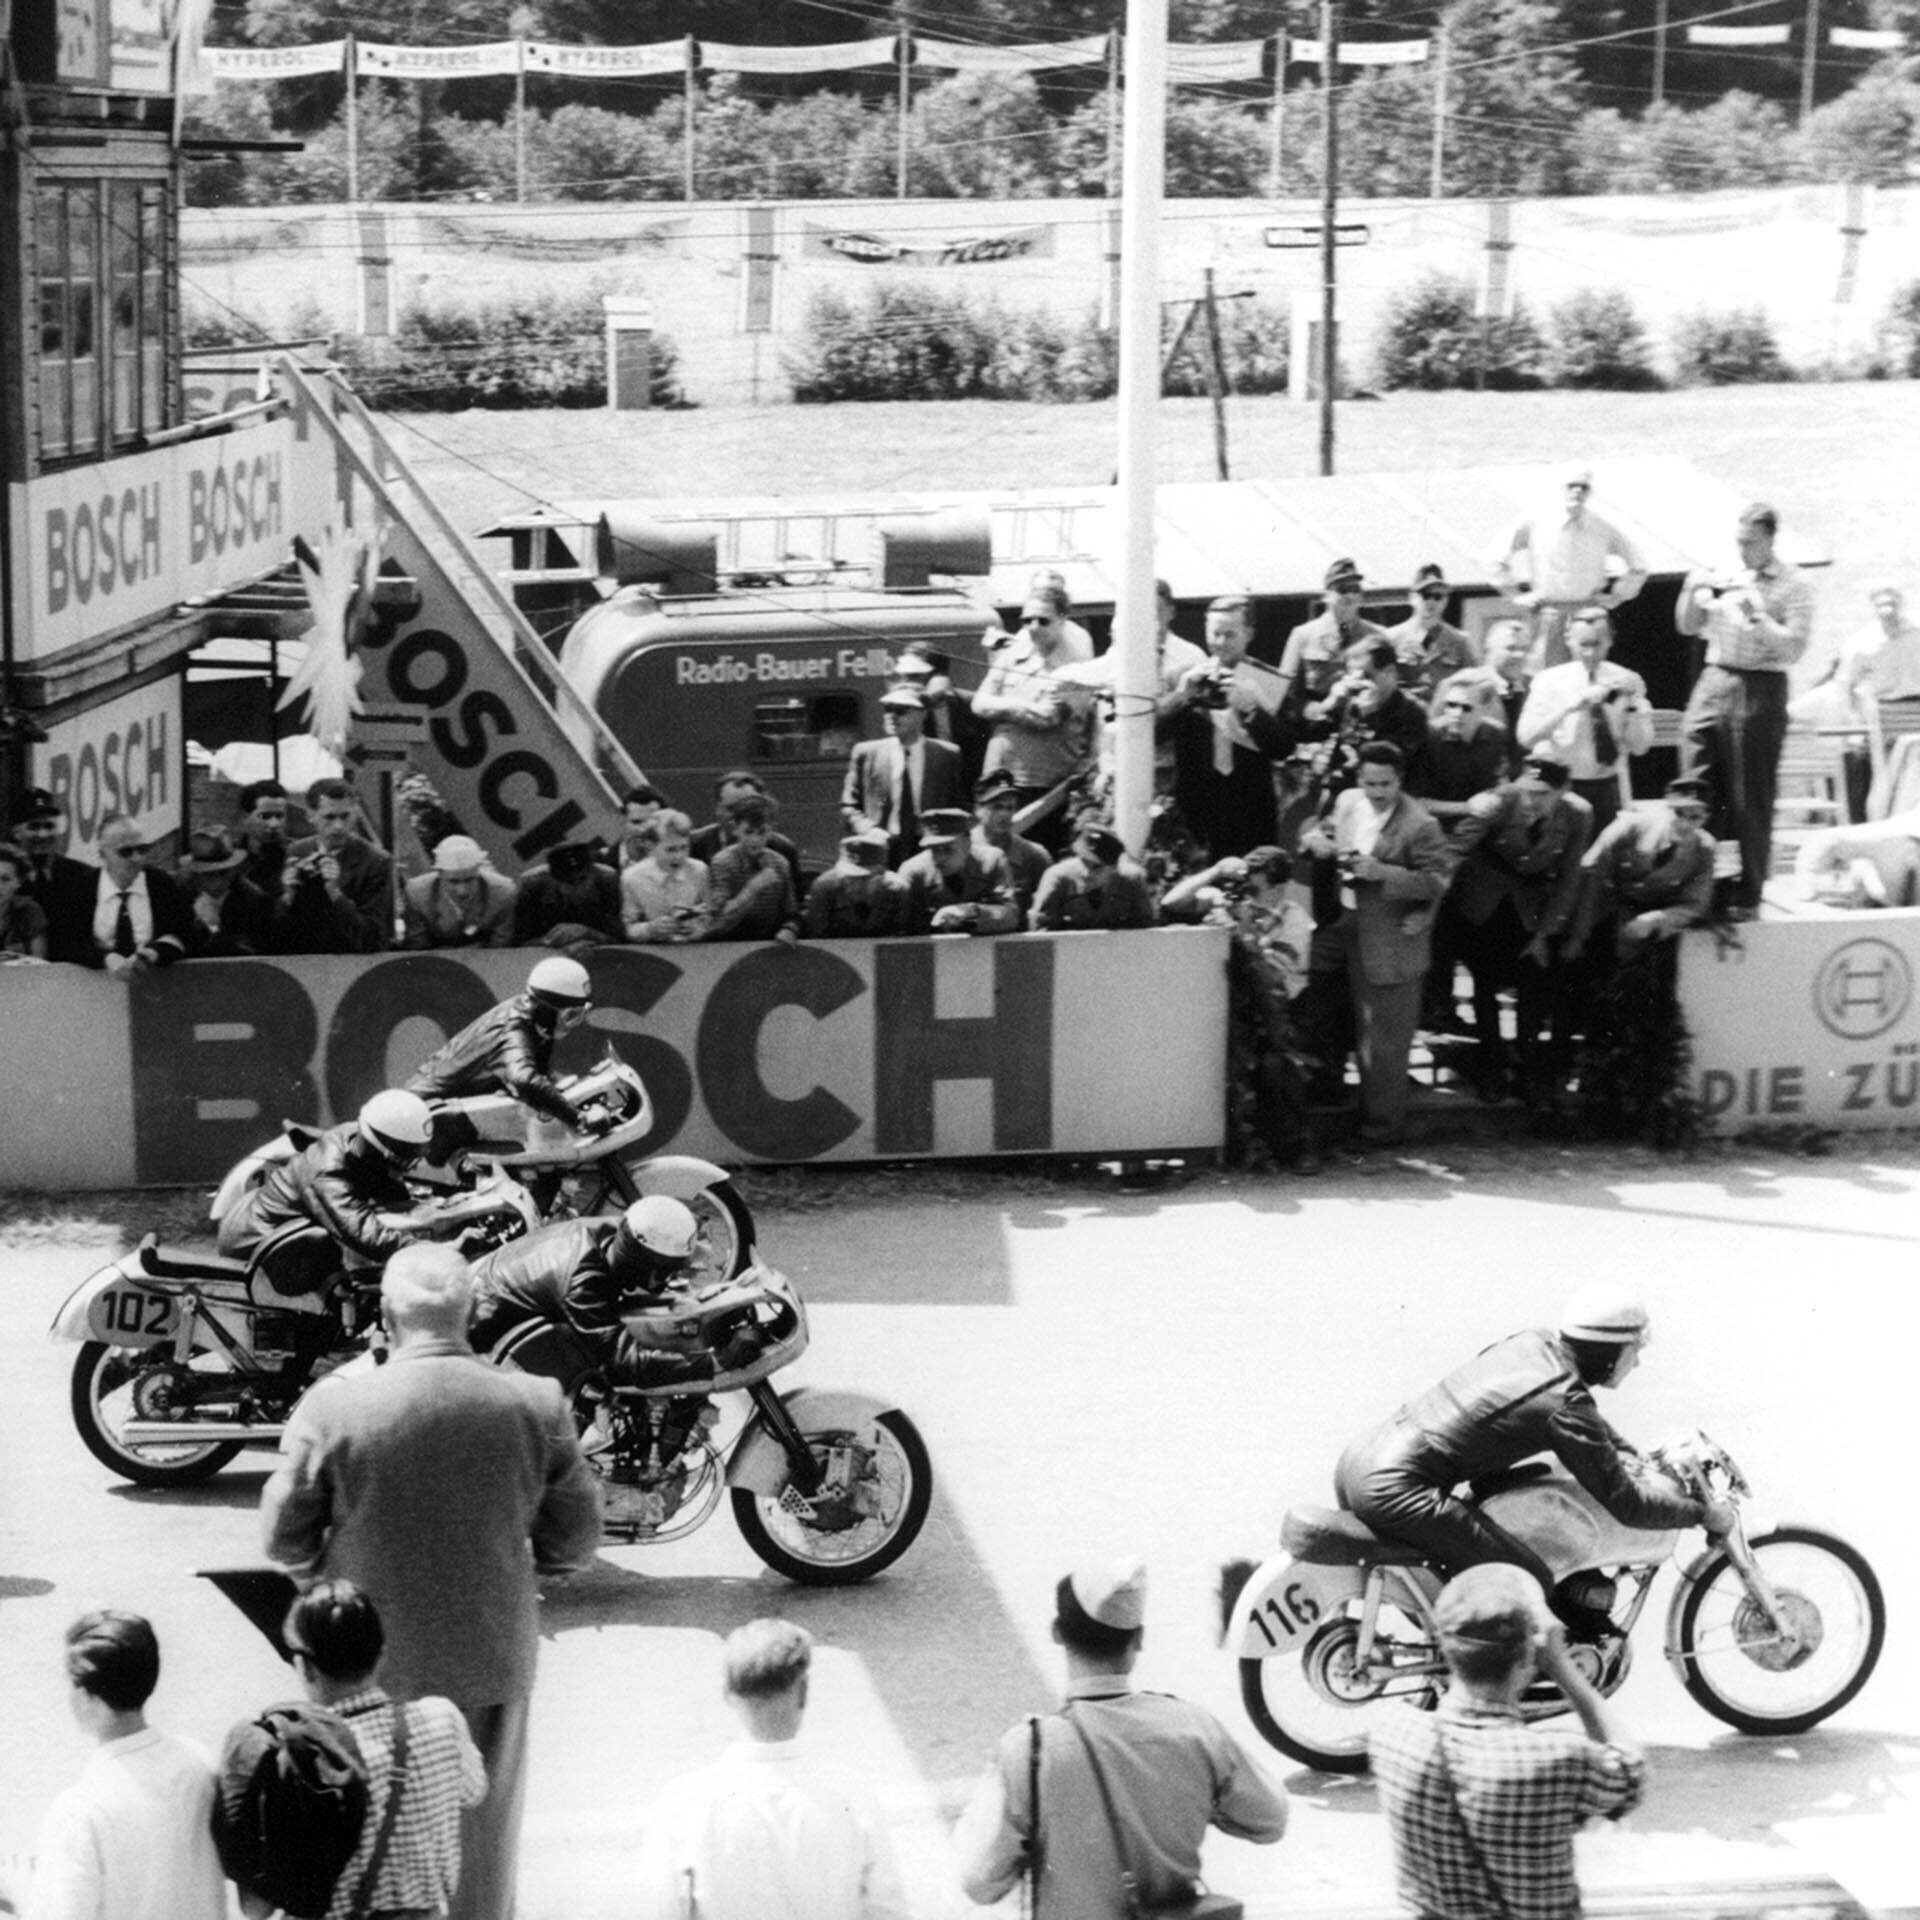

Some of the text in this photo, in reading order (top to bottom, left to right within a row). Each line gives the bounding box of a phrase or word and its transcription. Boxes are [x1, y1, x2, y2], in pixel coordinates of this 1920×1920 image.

[45, 481, 161, 613] BOSCH
[189, 449, 283, 566] BOSCH
[675, 651, 833, 685] Radio-Bauer
[50, 711, 167, 856] BOSCH
[131, 938, 1055, 1187] BOSCH
[1701, 1066, 1804, 1115] DIE
[102, 1290, 173, 1336] 102
[1249, 1583, 1321, 1648] 116
